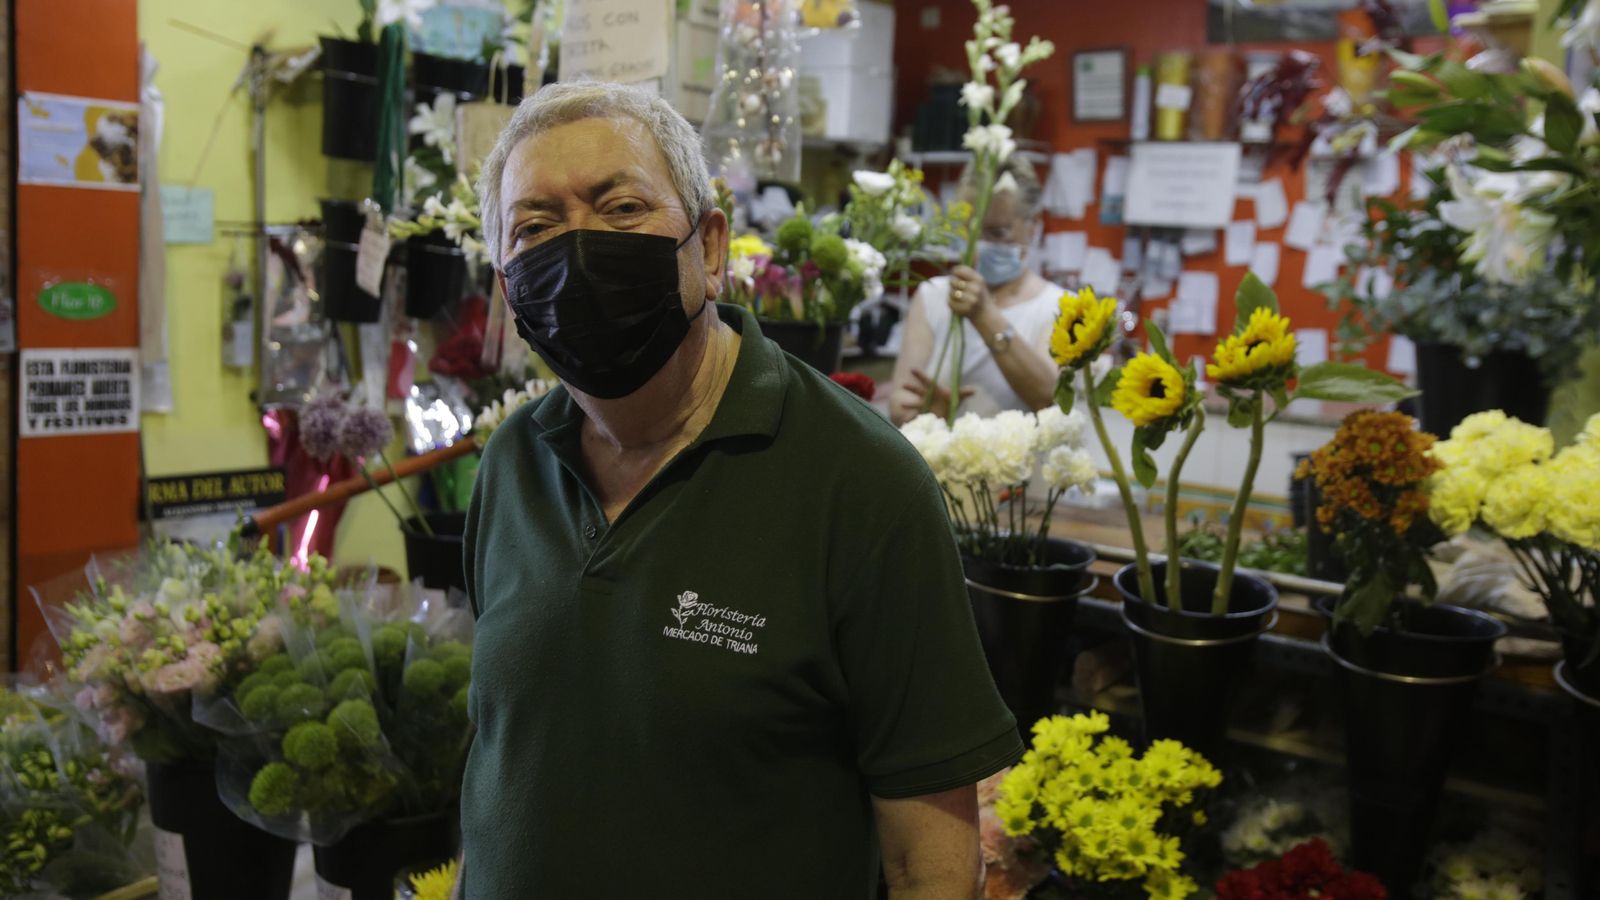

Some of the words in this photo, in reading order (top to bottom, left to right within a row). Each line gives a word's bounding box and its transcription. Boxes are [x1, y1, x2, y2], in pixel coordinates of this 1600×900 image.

[602, 11, 640, 27] CON
[26, 359, 54, 376] ESTA
[27, 380, 86, 396] PERMANECE
[27, 401, 58, 414] TODOS
[63, 400, 79, 412] LOS
[85, 399, 131, 411] DOMINGOS
[28, 418, 37, 429] Y
[43, 415, 128, 429] FESTIVOS
[191, 478, 224, 499] DEL
[228, 472, 286, 495] AUTOR
[695, 618, 753, 641] Antonio
[662, 626, 709, 643] MERCADO
[710, 635, 724, 647] DE
[726, 638, 758, 654] TRIANA
